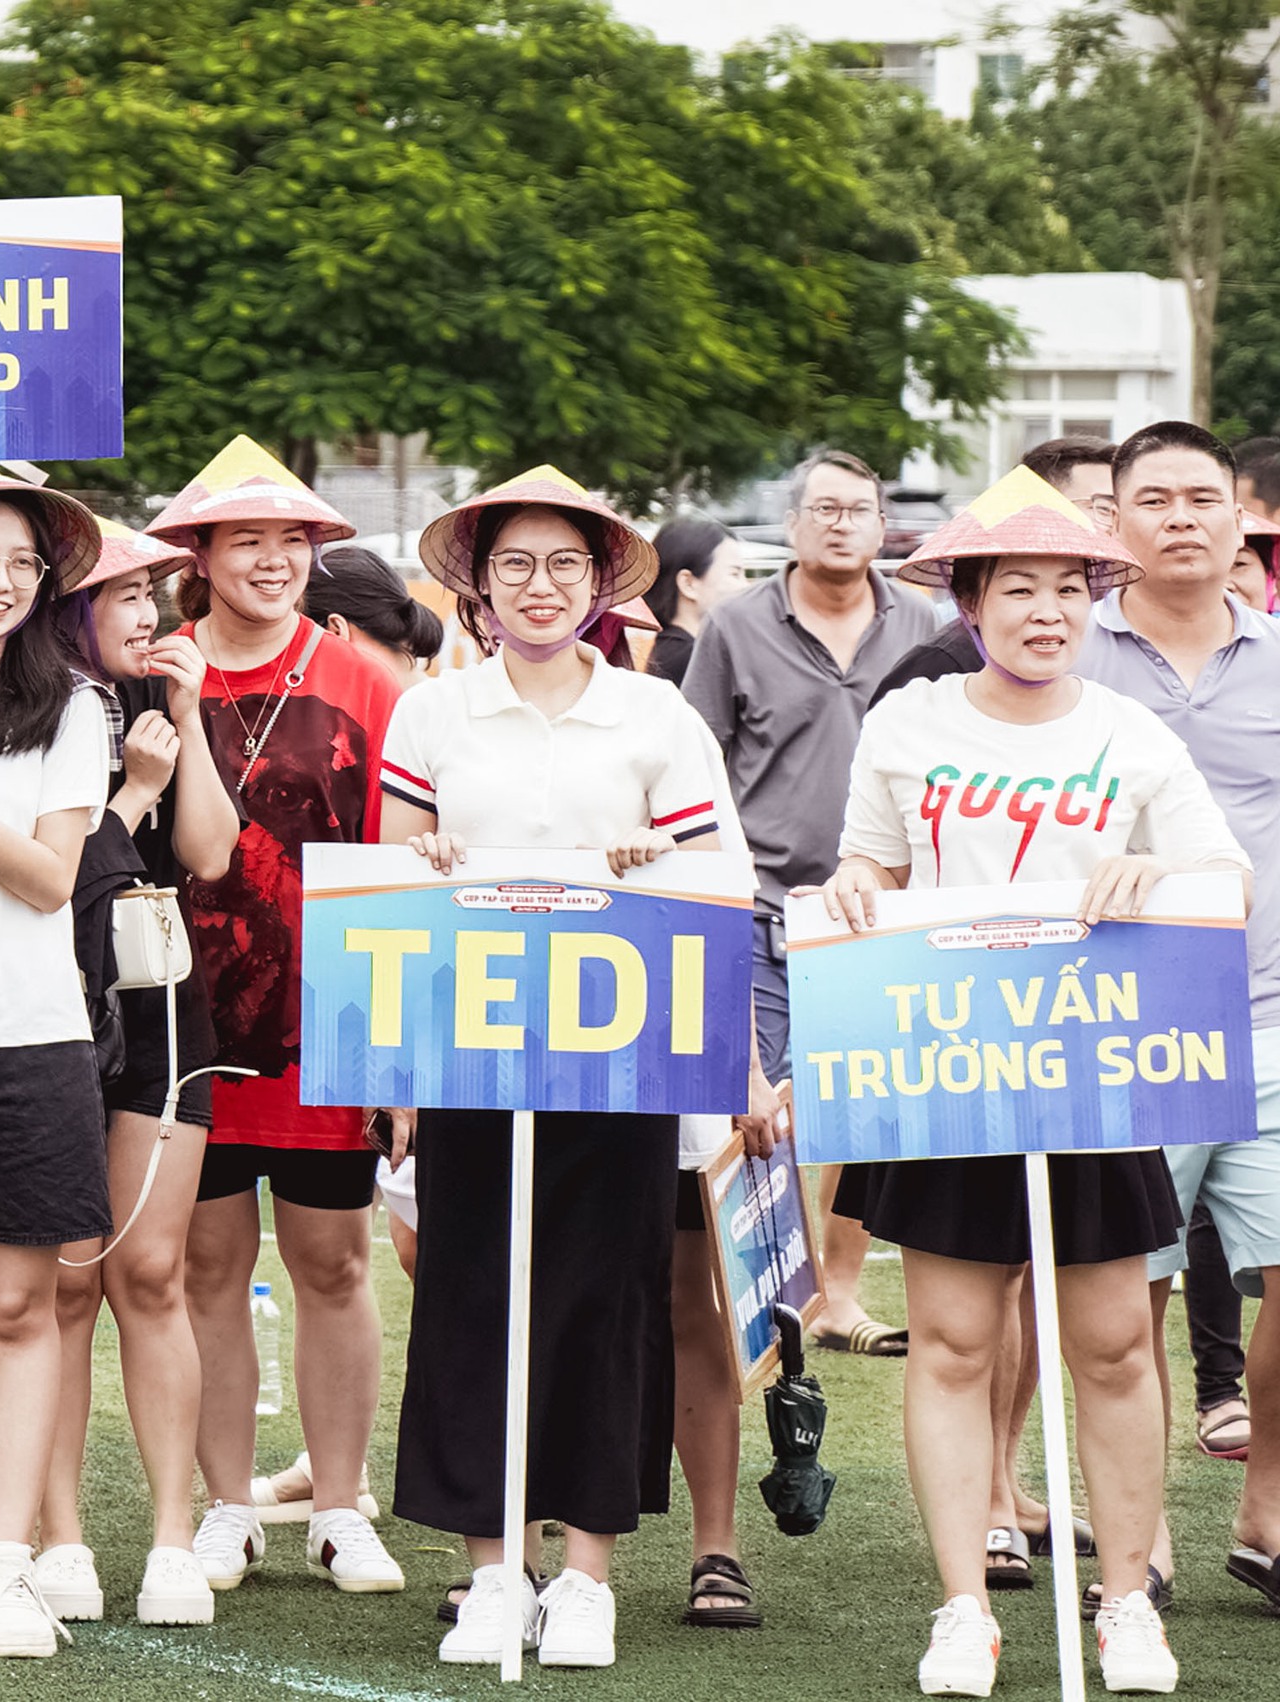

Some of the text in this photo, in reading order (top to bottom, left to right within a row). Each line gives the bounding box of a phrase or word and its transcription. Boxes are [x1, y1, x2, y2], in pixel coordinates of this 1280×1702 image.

[344, 928, 706, 1055] TEDI
[884, 956, 1139, 1032] TƯ VẤN
[807, 1026, 1227, 1101] TRƯỜNG SƠN
